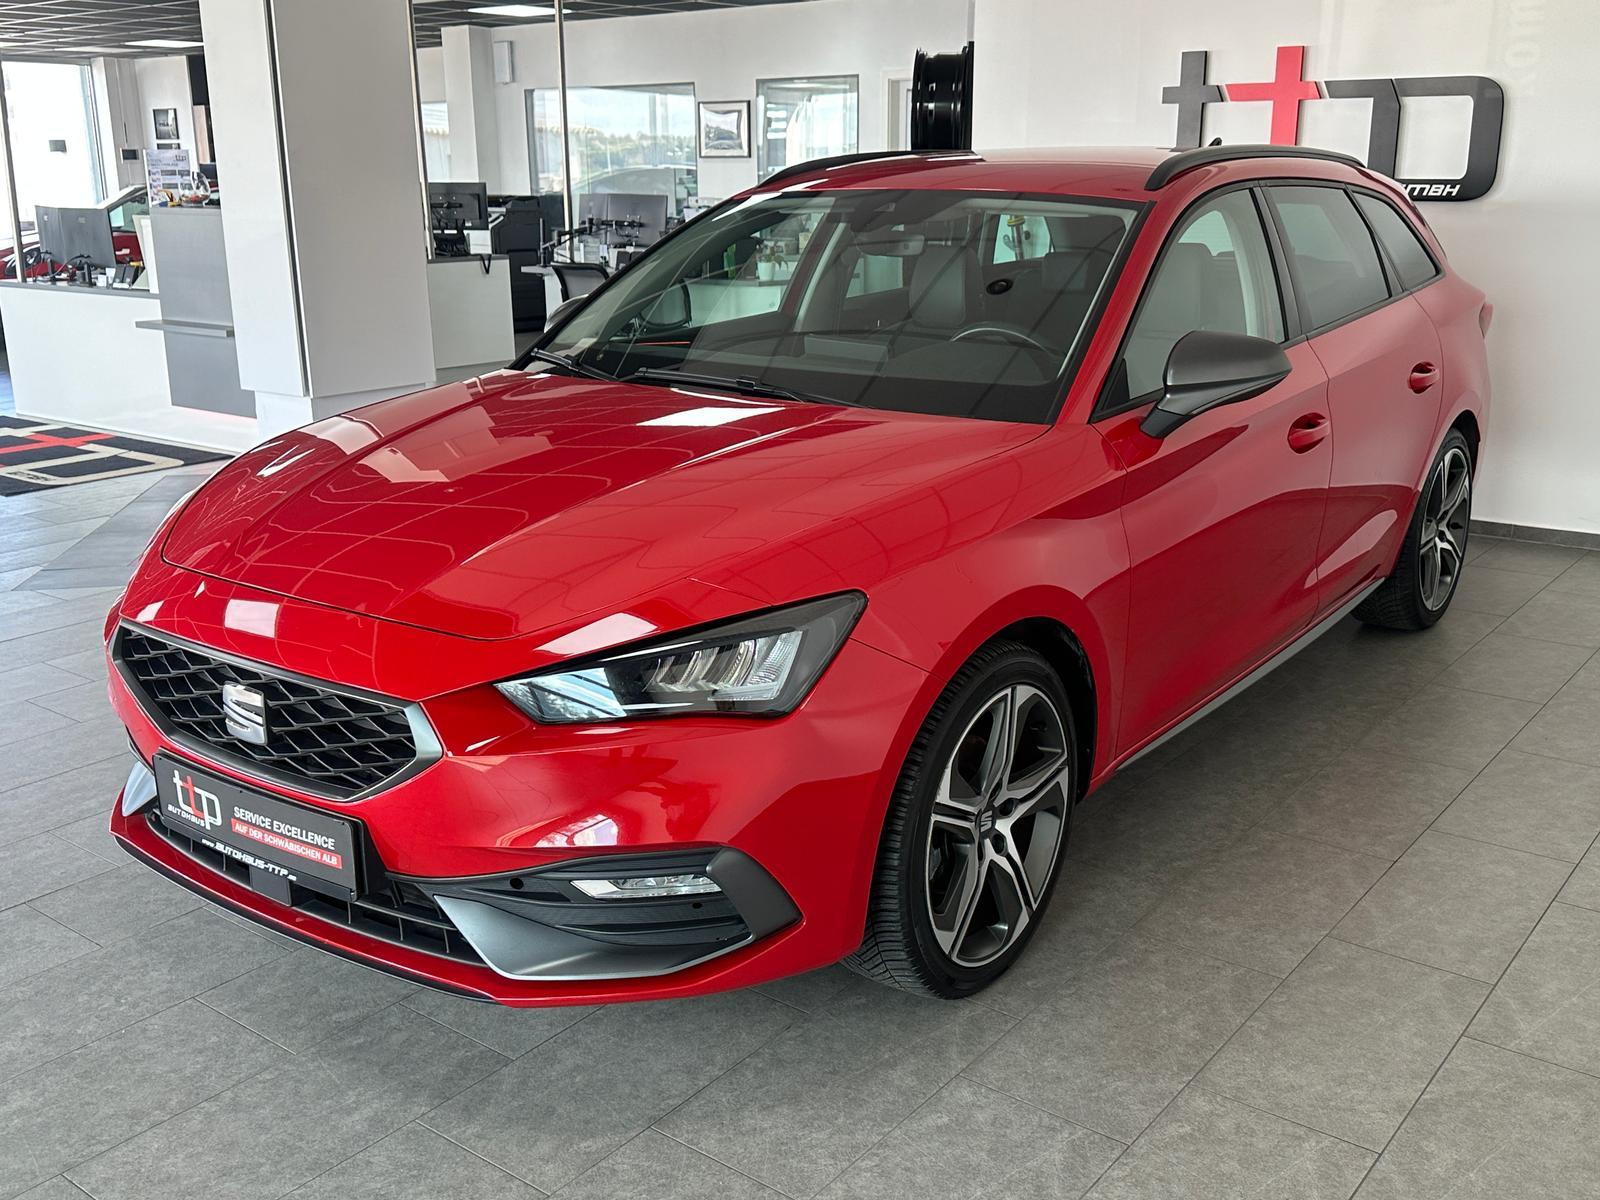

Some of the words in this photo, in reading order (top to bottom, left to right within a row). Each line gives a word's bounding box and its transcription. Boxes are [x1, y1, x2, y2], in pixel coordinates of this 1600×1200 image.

[233, 806, 272, 829] SERVICE
[273, 820, 336, 850] EXCELLENCE
[234, 822, 249, 834] AUF
[249, 828, 264, 840] DER
[321, 854, 338, 865] ALB
